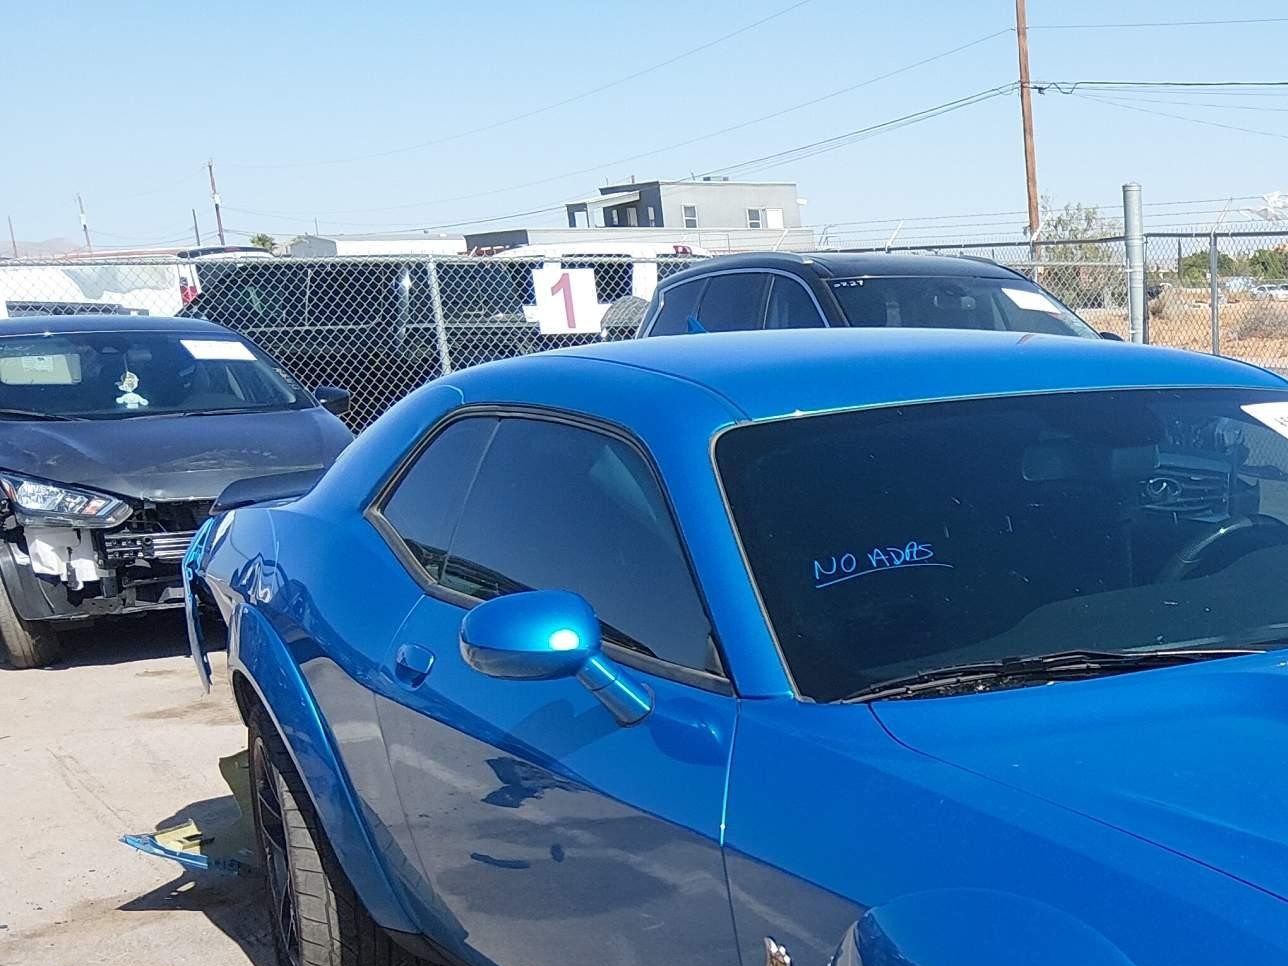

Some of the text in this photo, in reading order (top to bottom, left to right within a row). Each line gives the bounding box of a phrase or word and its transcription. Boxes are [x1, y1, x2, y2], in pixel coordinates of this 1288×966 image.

[551, 272, 576, 329] 1
[814, 541, 934, 579] NO ADAS
